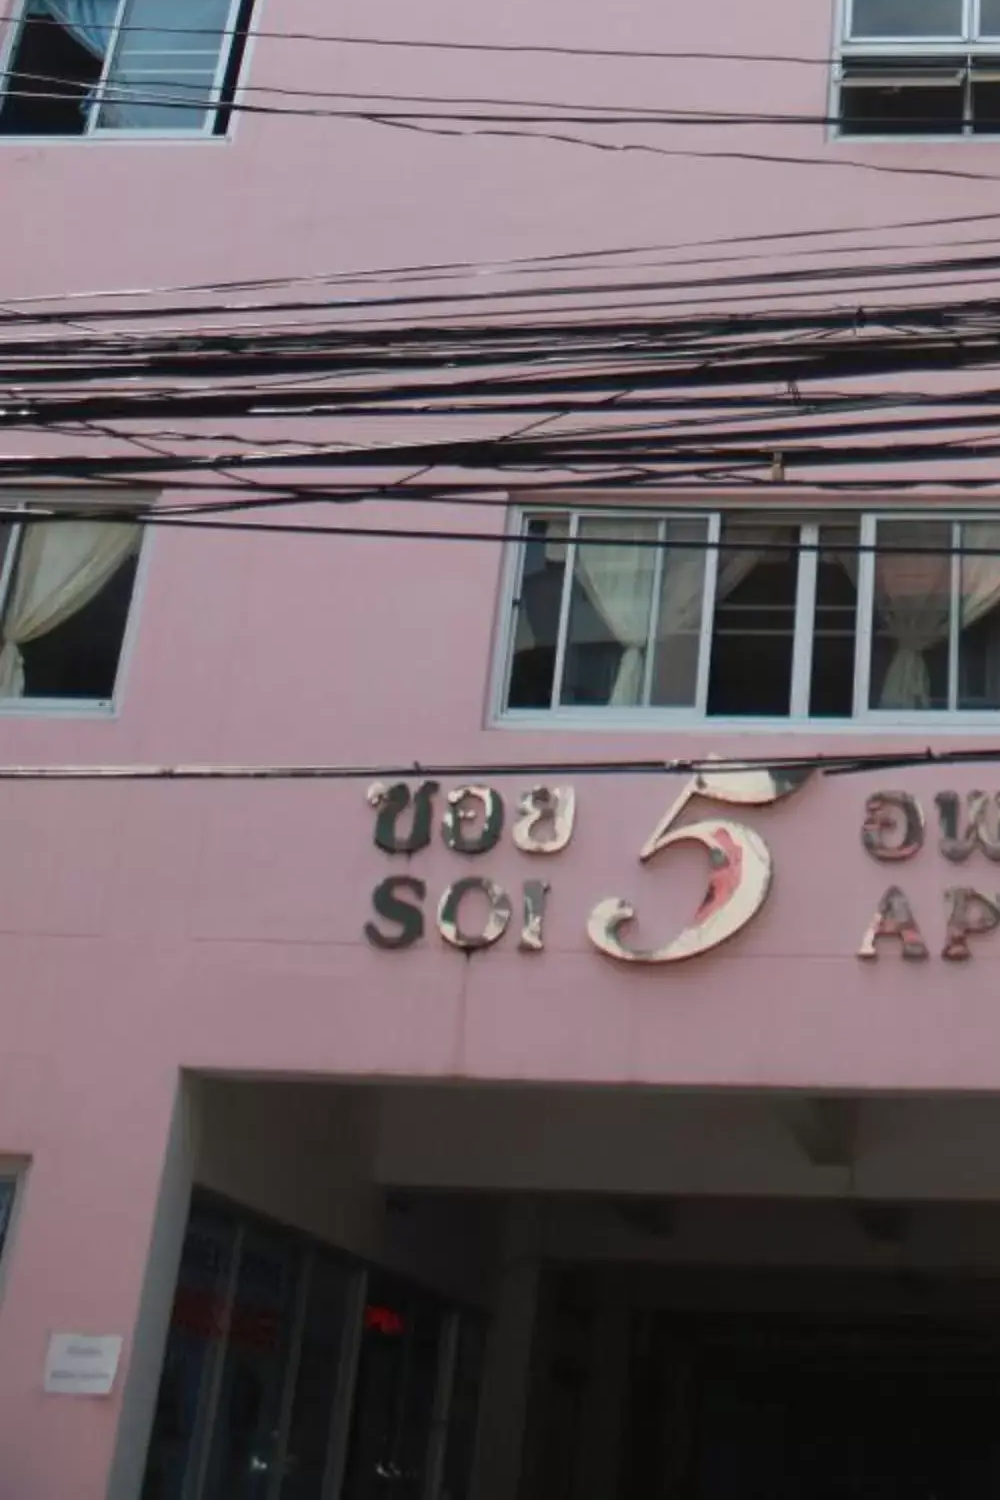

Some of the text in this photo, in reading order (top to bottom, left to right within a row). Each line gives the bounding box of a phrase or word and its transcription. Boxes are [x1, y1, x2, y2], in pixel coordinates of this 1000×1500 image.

[364, 874, 552, 952] SOI
[366, 779, 577, 854] ซอย
[586, 755, 818, 962] 5
